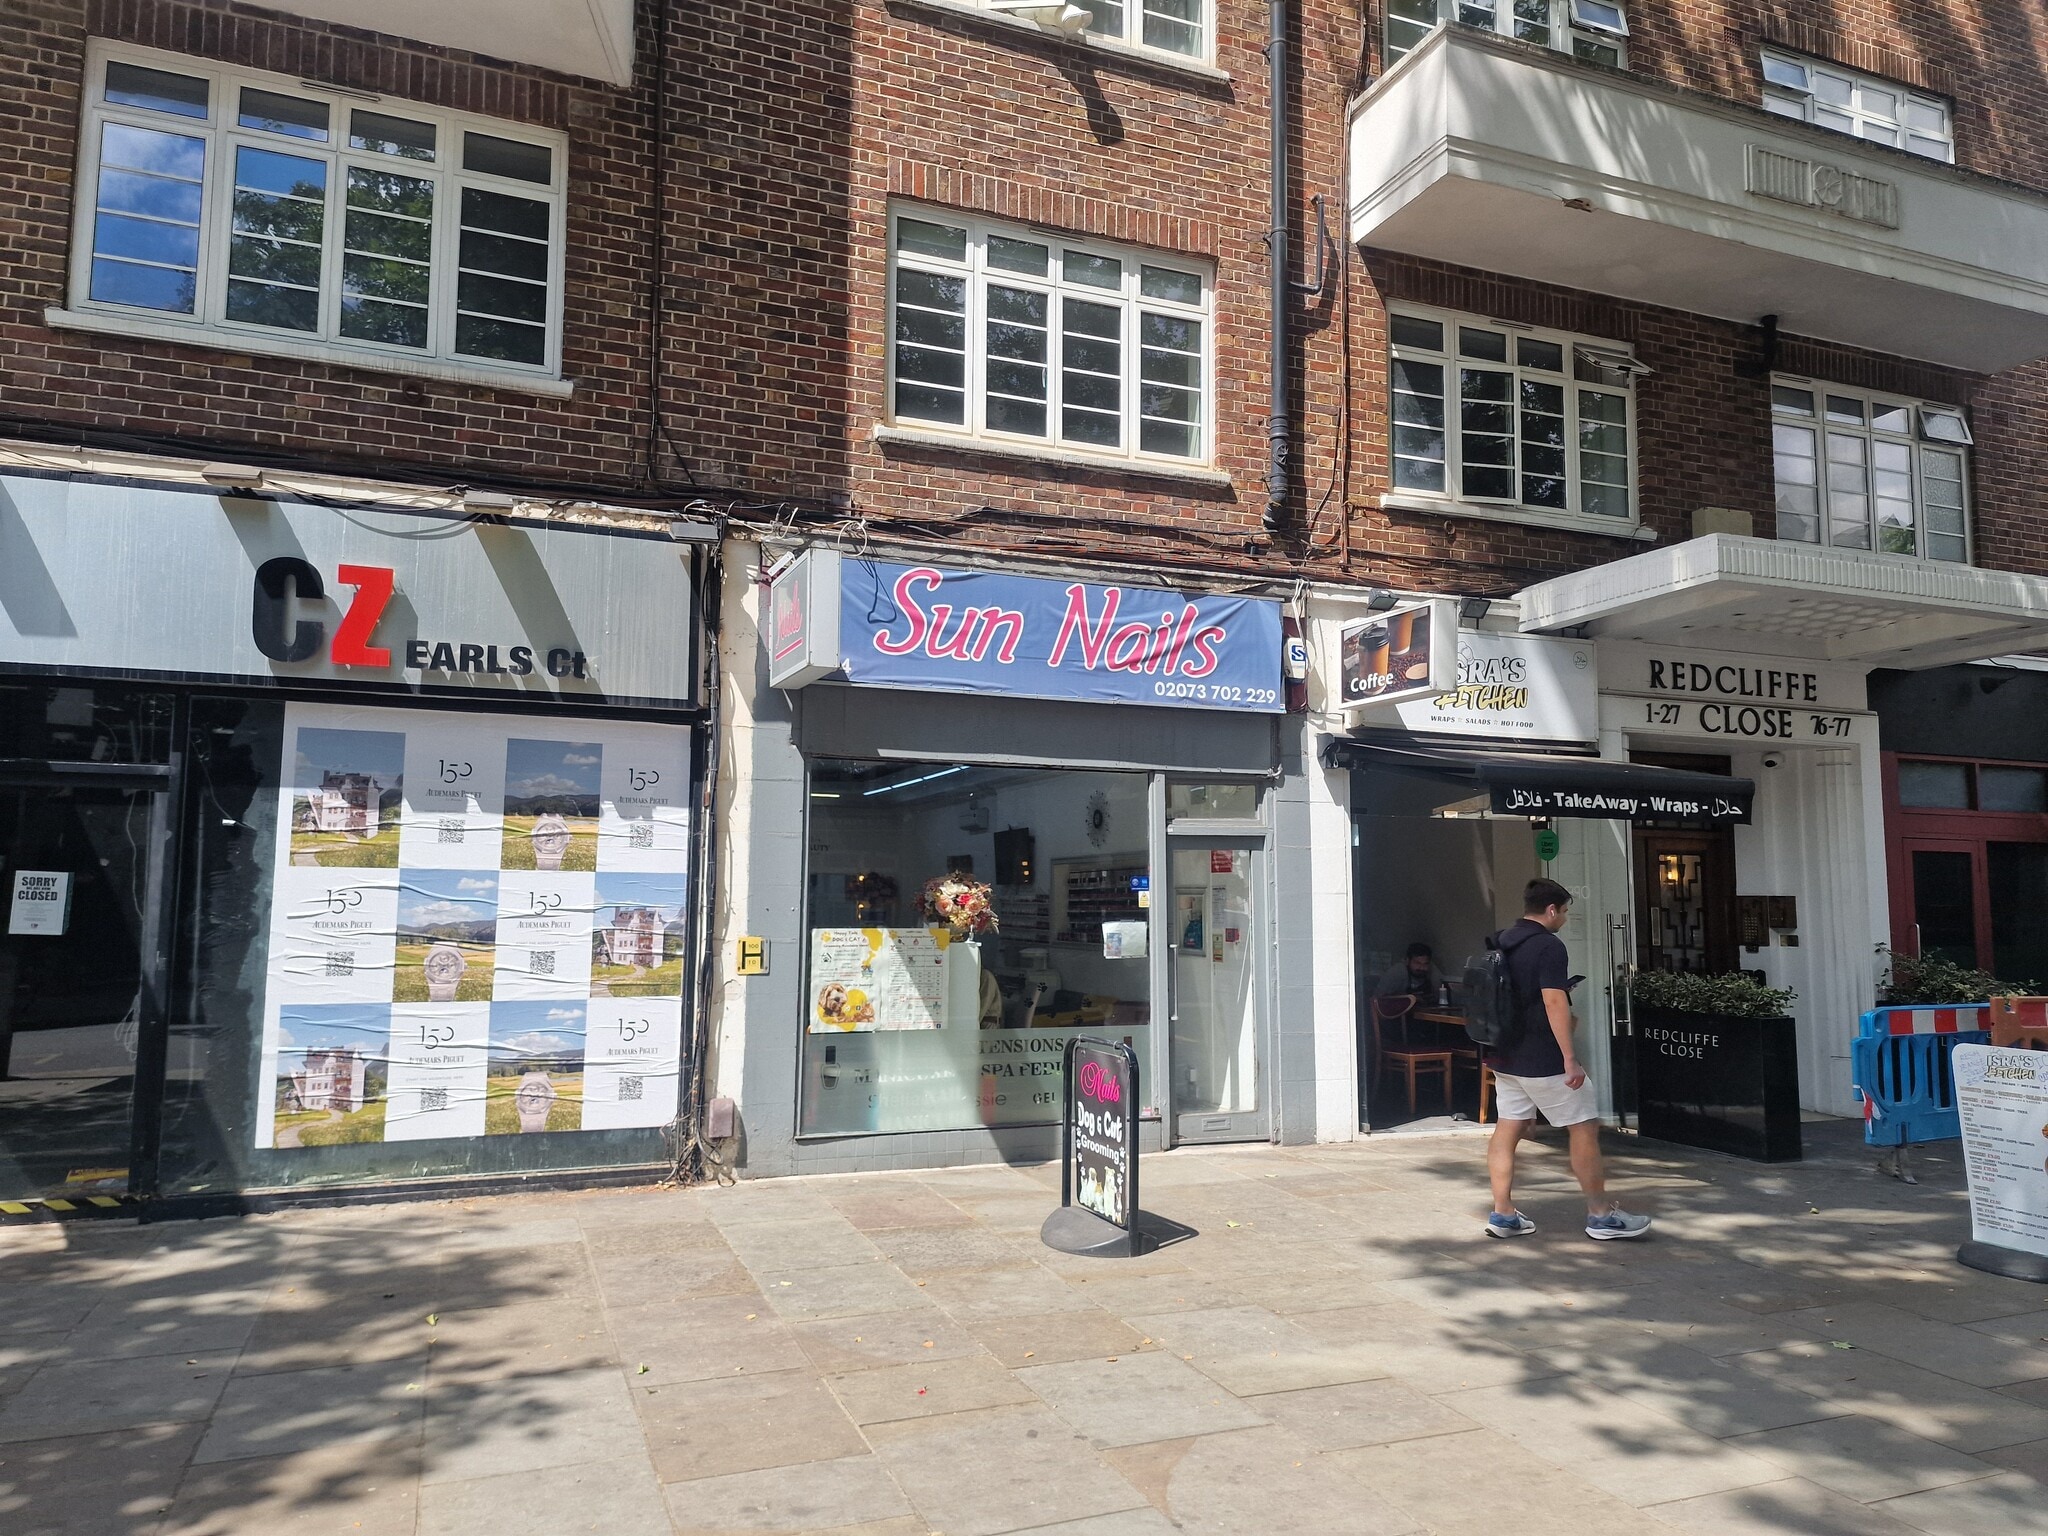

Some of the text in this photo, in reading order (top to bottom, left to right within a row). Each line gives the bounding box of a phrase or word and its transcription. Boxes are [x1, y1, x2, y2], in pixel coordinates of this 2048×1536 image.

[252, 557, 394, 667] CZ
[873, 567, 1225, 678] Sun Nails
[405, 640, 586, 679] EARLS Ct
[1457, 657, 1526, 684] SRA'S
[1350, 672, 1394, 692] Coffee
[1649, 659, 1818, 702] REDCLIFFE
[1154, 681, 1276, 704] 02073 702 229
[1430, 715, 1456, 723] WRAPS
[1465, 717, 1491, 725] SALADS
[1514, 721, 1534, 729] FOOD
[1646, 703, 1851, 738] 1-27 CLOSE 76-77
[425, 789, 460, 798] AUDEMARS
[618, 796, 669, 805] AUDEMARS PIGUET
[1506, 788, 1542, 810] فلافل
[1553, 792, 1699, 816] TakeAway Wraps
[1711, 798, 1743, 817] حلال
[22, 876, 57, 887] SORRY
[18, 890, 58, 901] CLOSED
[312, 920, 373, 929] AUDEMARS PIGUET
[516, 920, 571, 929] AUDEMARS PIGUET
[979, 1038, 1064, 1054] TENSIONS
[1645, 1027, 1719, 1047] REDCLIFFE
[409, 1055, 464, 1064] AUDEMARS PIGUET
[606, 1047, 659, 1056] AUDEMARS PIGUET
[1660, 1043, 1703, 1059] CLOSE
[981, 1062, 1062, 1077] SPA PEDI
[1986, 1054, 2034, 1068] ISRA'S
[1080, 1062, 1120, 1103] Nails
[1077, 1101, 1095, 1137] Dog
[1103, 1110, 1122, 1142] Cat
[1080, 1134, 1120, 1165] Grooming
